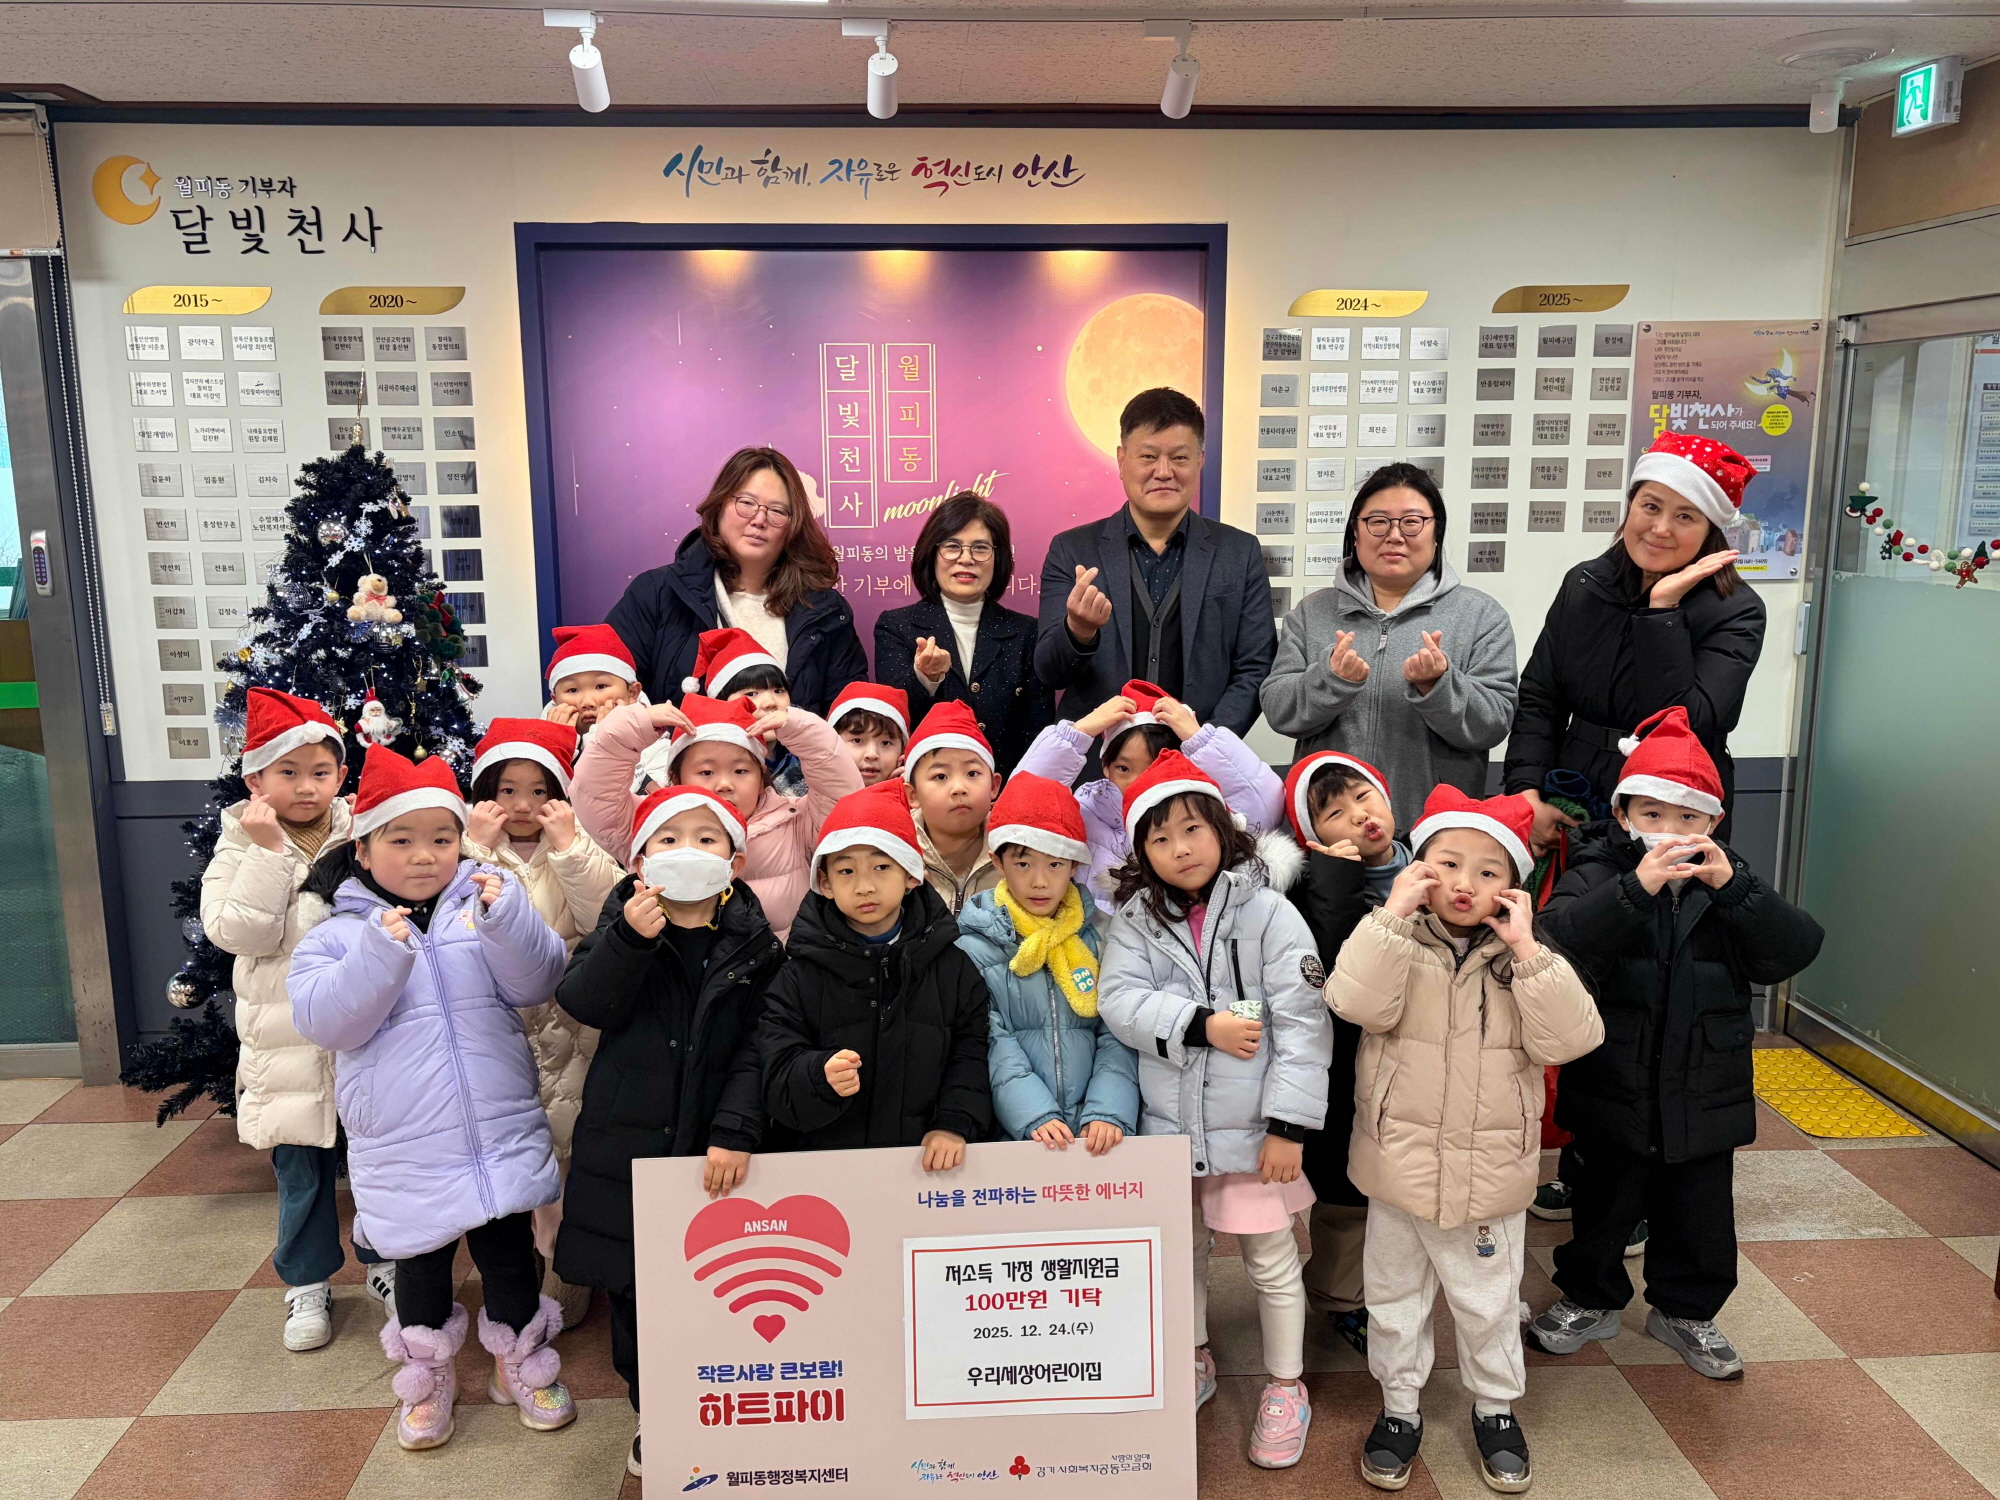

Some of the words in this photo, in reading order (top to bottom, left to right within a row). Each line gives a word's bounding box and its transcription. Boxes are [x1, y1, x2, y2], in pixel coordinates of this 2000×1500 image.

[663, 144, 750, 198] 시민과
[820, 157, 902, 200] 자유로운
[911, 156, 1003, 197] 혁신도시
[1012, 153, 1086, 187] 안산
[174, 176, 232, 199] 월피동
[239, 176, 297, 198] 기부자
[1652, 391, 1674, 399] 월피동
[1677, 390, 1702, 400] 기부자,
[897, 354, 922, 473] 월피동
[1711, 420, 1727, 430] 되어
[1729, 420, 1757, 429] 주세요!
[854, 575, 911, 596] 기부에
[917, 1189, 967, 1209] 나눔을
[973, 1186, 1037, 1207] 전파하는
[1042, 1182, 1091, 1203] 따뜻한
[1096, 1181, 1144, 1201] 에너지
[744, 1219, 788, 1233] ANSAN
[945, 1262, 993, 1285] 저소득
[1002, 1261, 1033, 1284] 가정
[1041, 1257, 1120, 1281] 생활지원금
[965, 1289, 1048, 1313] 100만원
[1061, 1287, 1102, 1308] 기탁
[973, 1326, 1013, 1340] 2025.
[1020, 1324, 1042, 1338] 12.
[1049, 1321, 1094, 1338] 24.(수)
[697, 1363, 774, 1384] 작은사랑
[780, 1360, 844, 1381] 큰보람!
[967, 1361, 1102, 1388] 우리세상어린이집
[698, 1388, 845, 1428] 하트파이
[1500, 1419, 1510, 1431] M
[726, 1467, 849, 1487] 월피동행정복지센터
[977, 1470, 999, 1480] 안산
